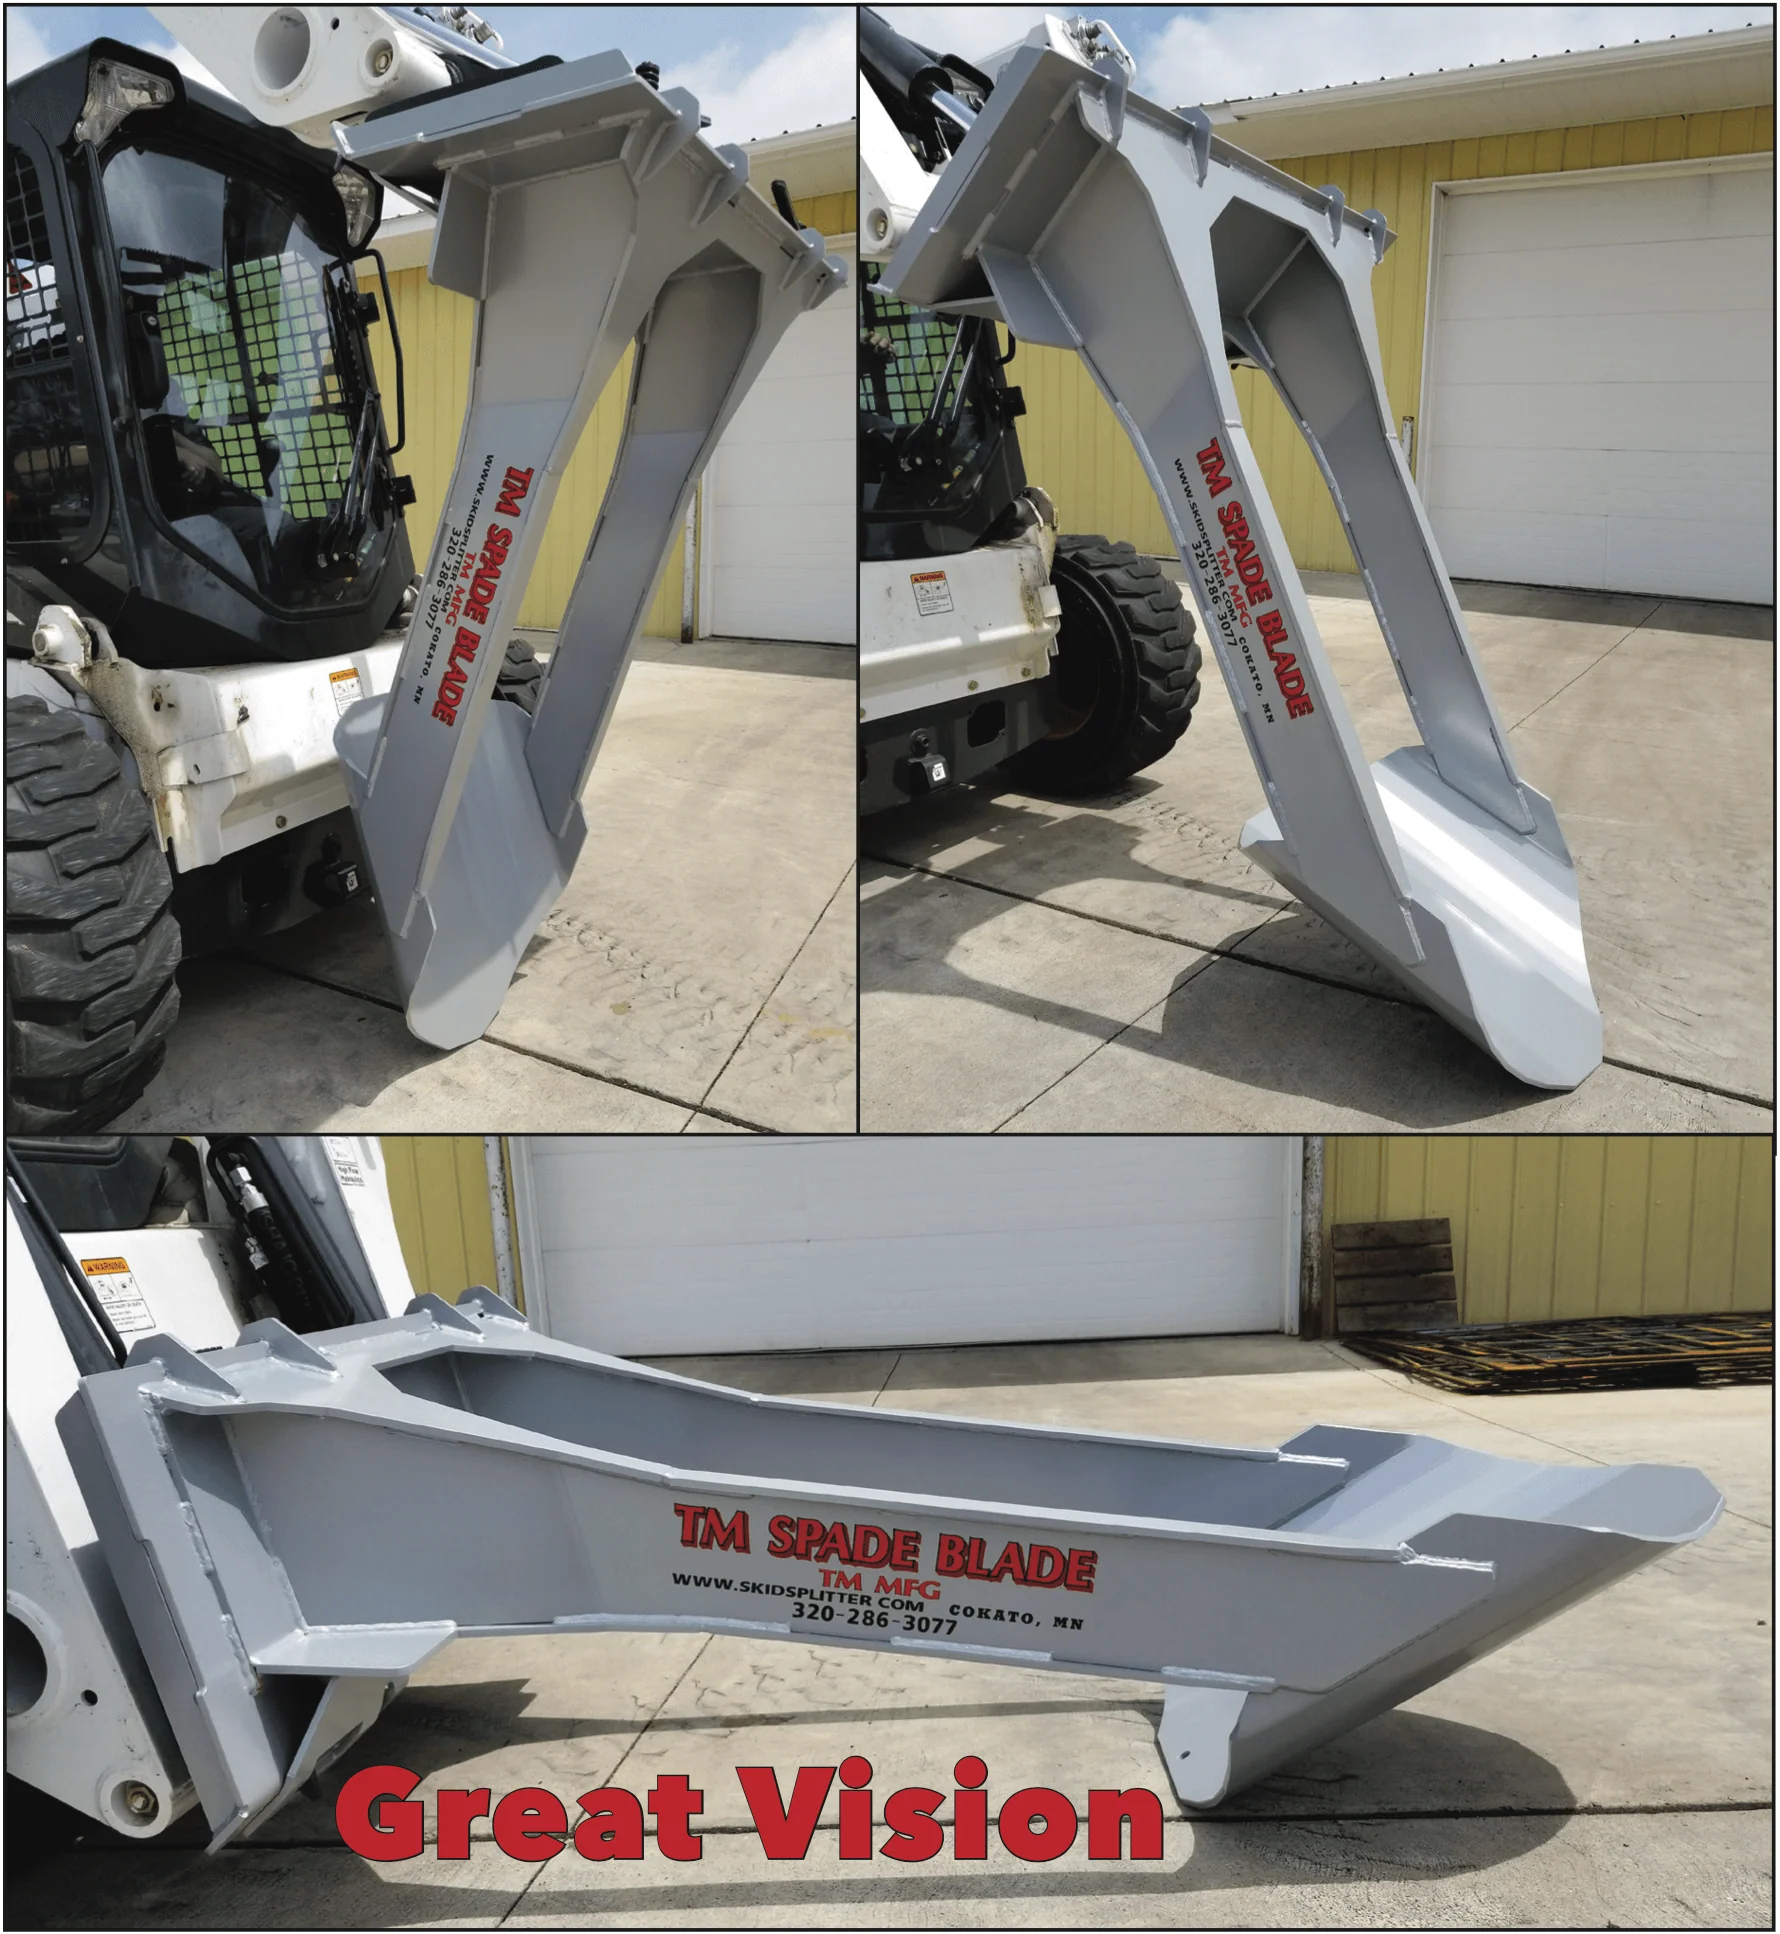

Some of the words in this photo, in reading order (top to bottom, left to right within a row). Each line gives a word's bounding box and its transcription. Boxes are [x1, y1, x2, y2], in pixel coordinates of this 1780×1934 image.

[494, 466, 535, 517] TM
[425, 527, 462, 630] 320-286-3077
[459, 552, 477, 579] TM
[462, 523, 513, 625] SPADE
[1196, 437, 1233, 499] TM
[1217, 500, 1273, 607] SPADE
[1256, 609, 1314, 720] BLADE
[1216, 545, 1234, 579] TM
[1228, 584, 1252, 628] MFG
[445, 584, 466, 627] MFG
[1192, 541, 1238, 647] 320-286-3077
[419, 626, 442, 680] COKATO,
[431, 625, 482, 728] BLADE
[1239, 636, 1263, 697] COKATO,
[1262, 703, 1275, 723] MN
[413, 685, 425, 704] MN
[93, 1261, 126, 1271] WARNING
[674, 1503, 750, 1554] TM
[767, 1515, 922, 1573] SPADE
[935, 1533, 1098, 1594] BLADE
[818, 1568, 862, 1591] TM
[874, 1575, 941, 1600] MFG
[792, 1602, 957, 1635] 320-286-3077
[949, 1604, 1041, 1628] COKATO,
[1053, 1616, 1084, 1630] MN
